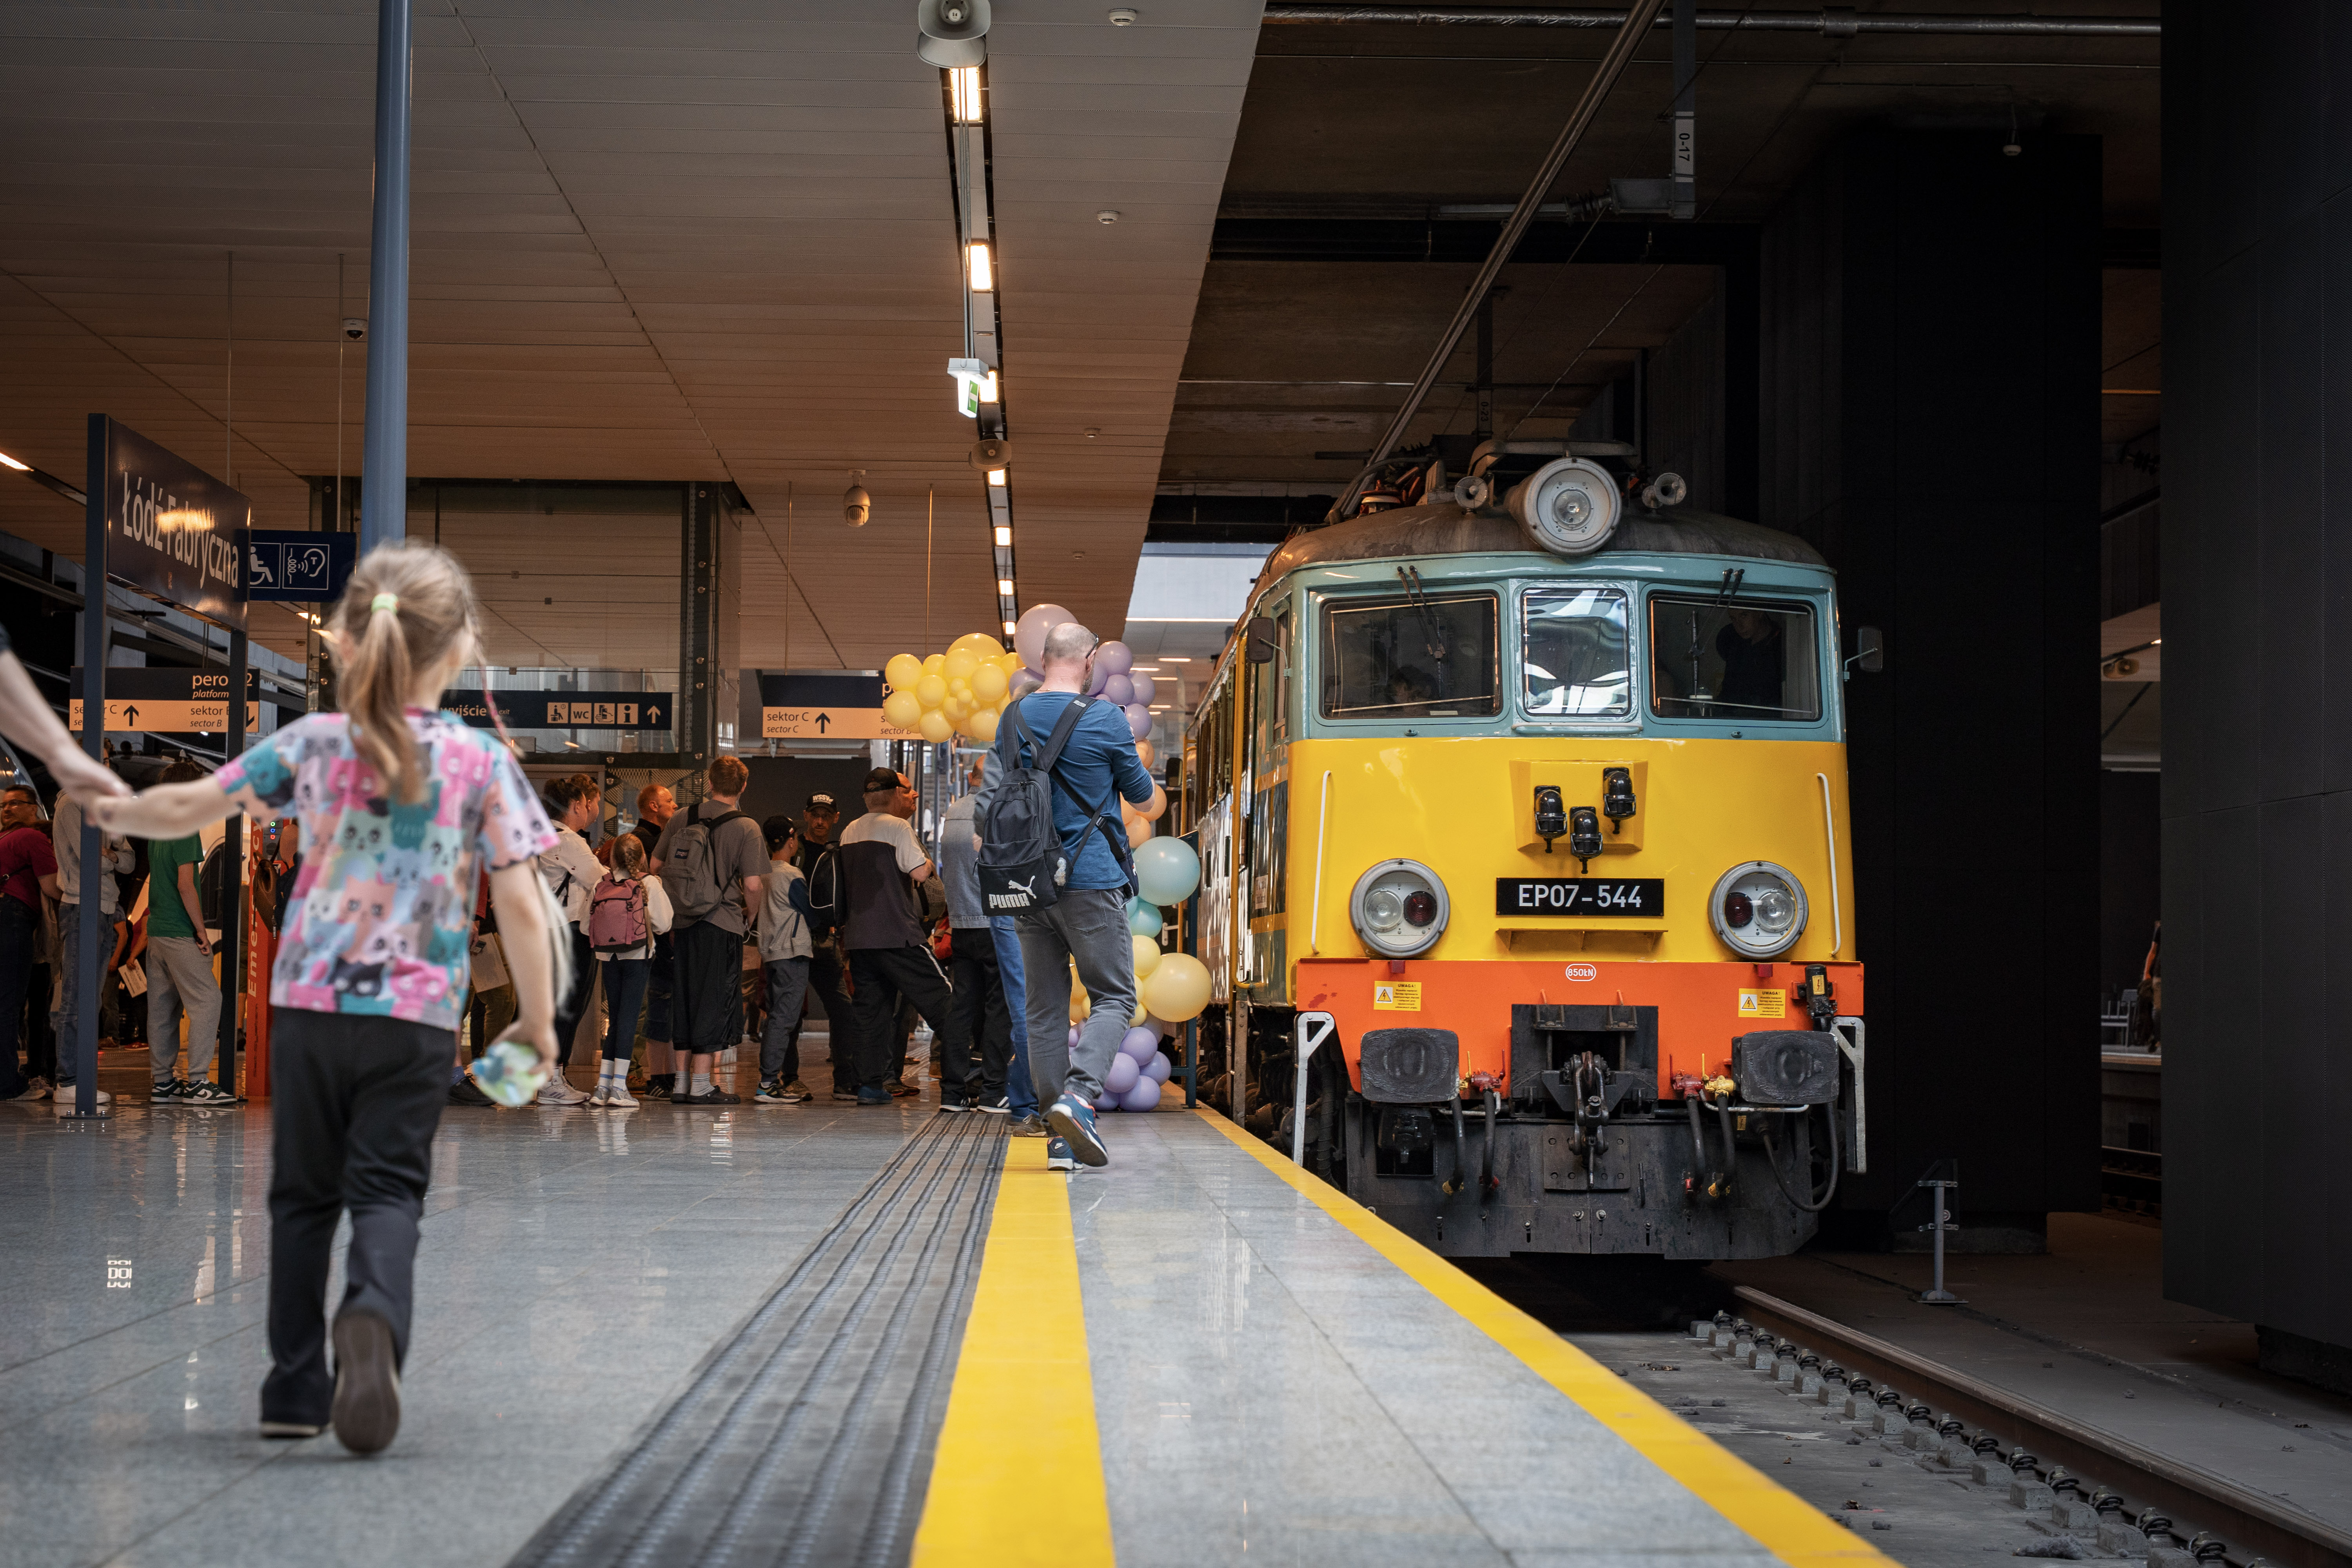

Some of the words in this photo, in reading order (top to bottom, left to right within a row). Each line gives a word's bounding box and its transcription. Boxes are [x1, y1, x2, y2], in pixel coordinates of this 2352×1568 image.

[1679, 132, 1690, 162] 0-17
[122, 472, 163, 552] Łódź
[167, 494, 238, 589] Fabryczna
[192, 675, 229, 690] pero
[192, 689, 229, 700] platform
[110, 704, 117, 714] C
[191, 705, 223, 715] sektor
[573, 711, 589, 719] WC
[767, 711, 799, 721] sektor
[802, 712, 809, 721] C
[989, 893, 1031, 909] PUMA
[1519, 884, 1642, 907] EP07-544
[1568, 968, 1594, 976] 850kN
